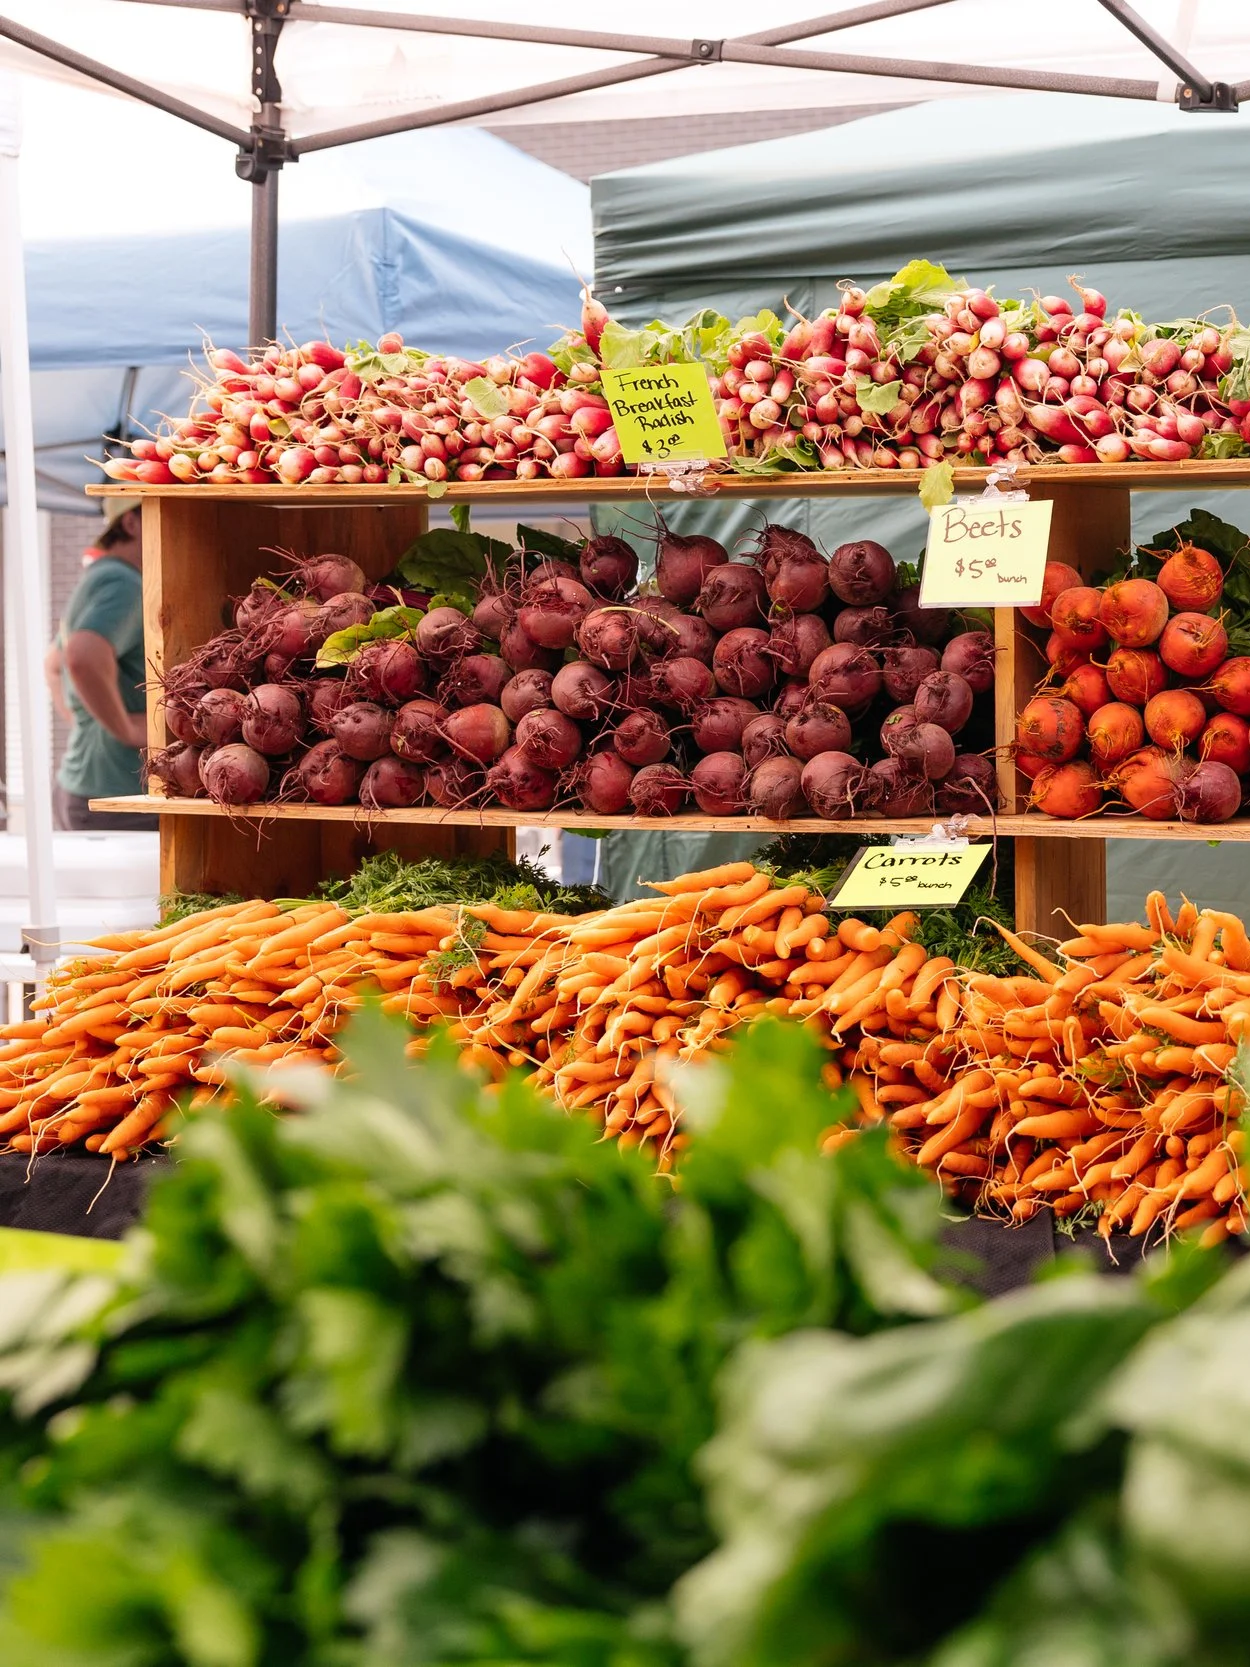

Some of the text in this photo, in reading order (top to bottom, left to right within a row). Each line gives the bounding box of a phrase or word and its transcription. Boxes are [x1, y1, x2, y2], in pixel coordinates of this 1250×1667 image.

[613, 372, 679, 391] French
[612, 391, 698, 417] Breakfast
[634, 410, 695, 432] Radish
[941, 507, 1022, 543] Beets
[997, 573, 1027, 584] bunch
[863, 852, 963, 870] Carrots
[917, 881, 952, 889] bunch
